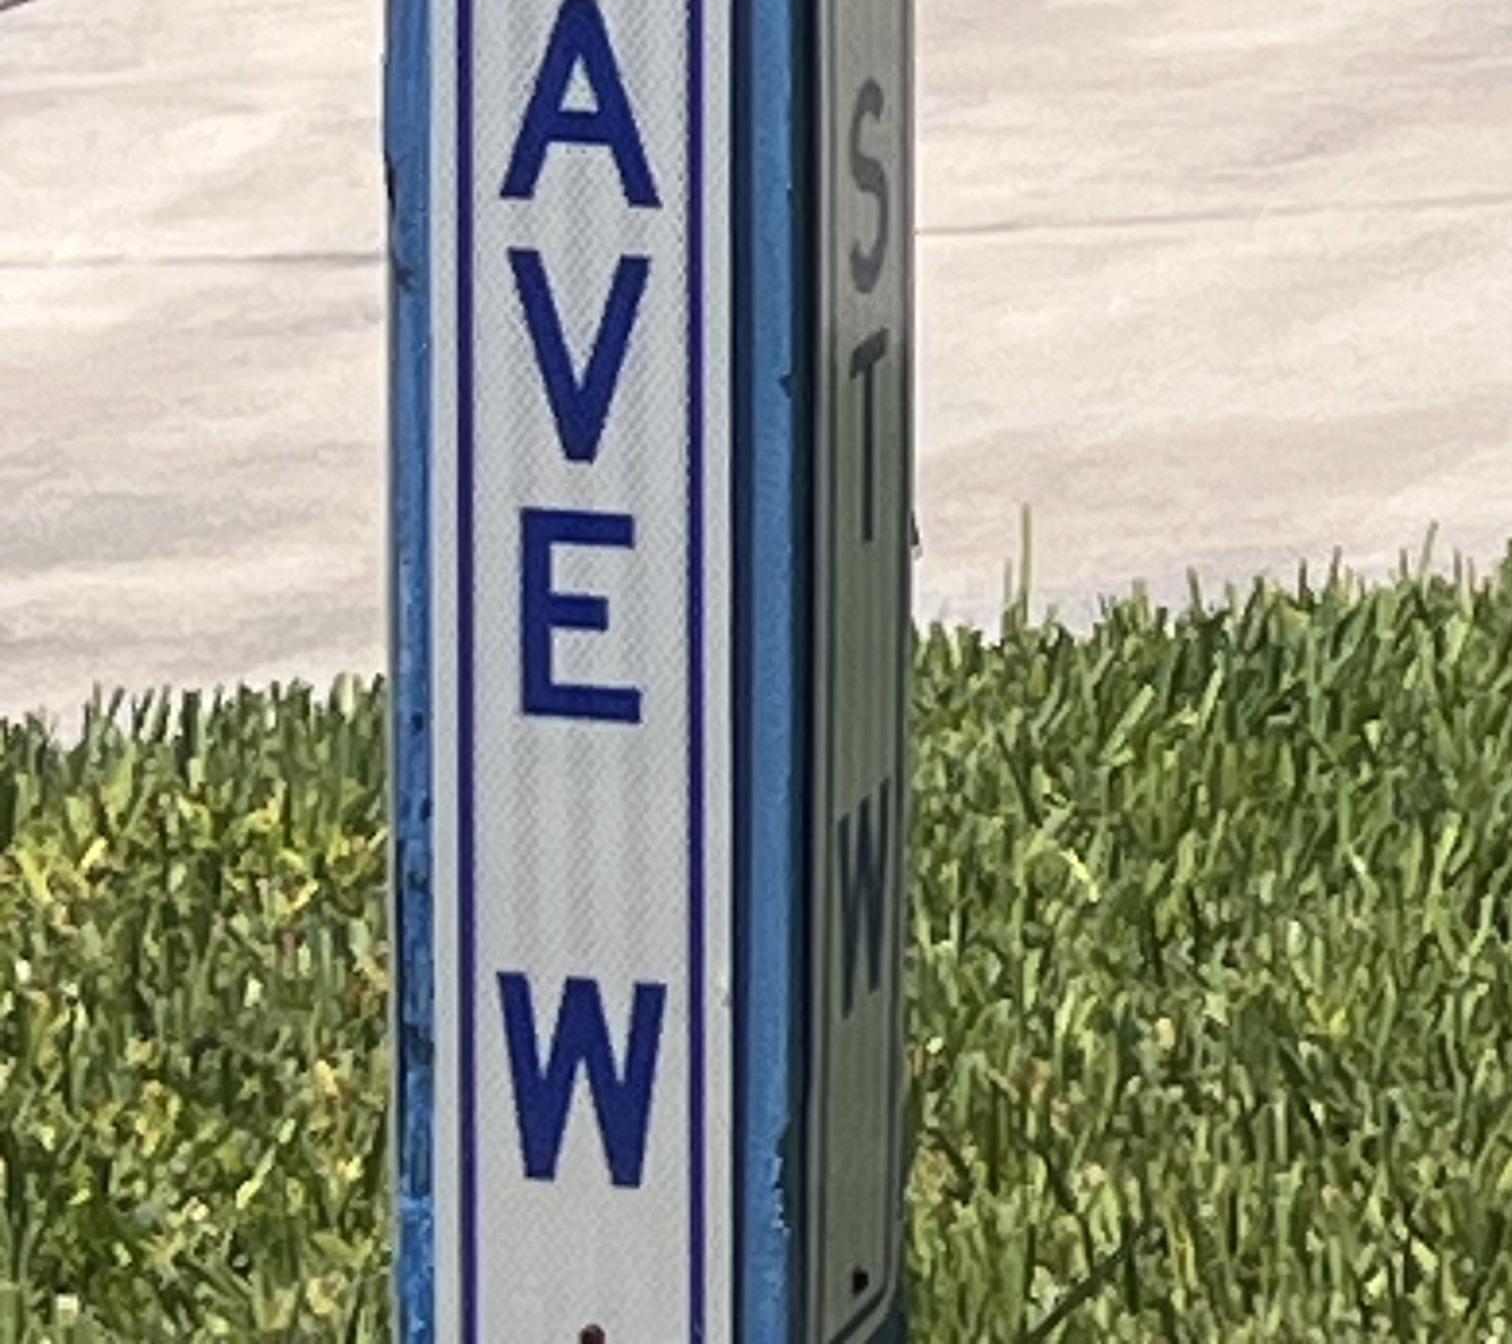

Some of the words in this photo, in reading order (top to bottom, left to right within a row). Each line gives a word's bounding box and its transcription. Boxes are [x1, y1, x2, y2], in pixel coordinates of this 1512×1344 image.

[850, 77, 889, 543] ST
[837, 776, 888, 1019] W
[496, 972, 667, 1188] W
